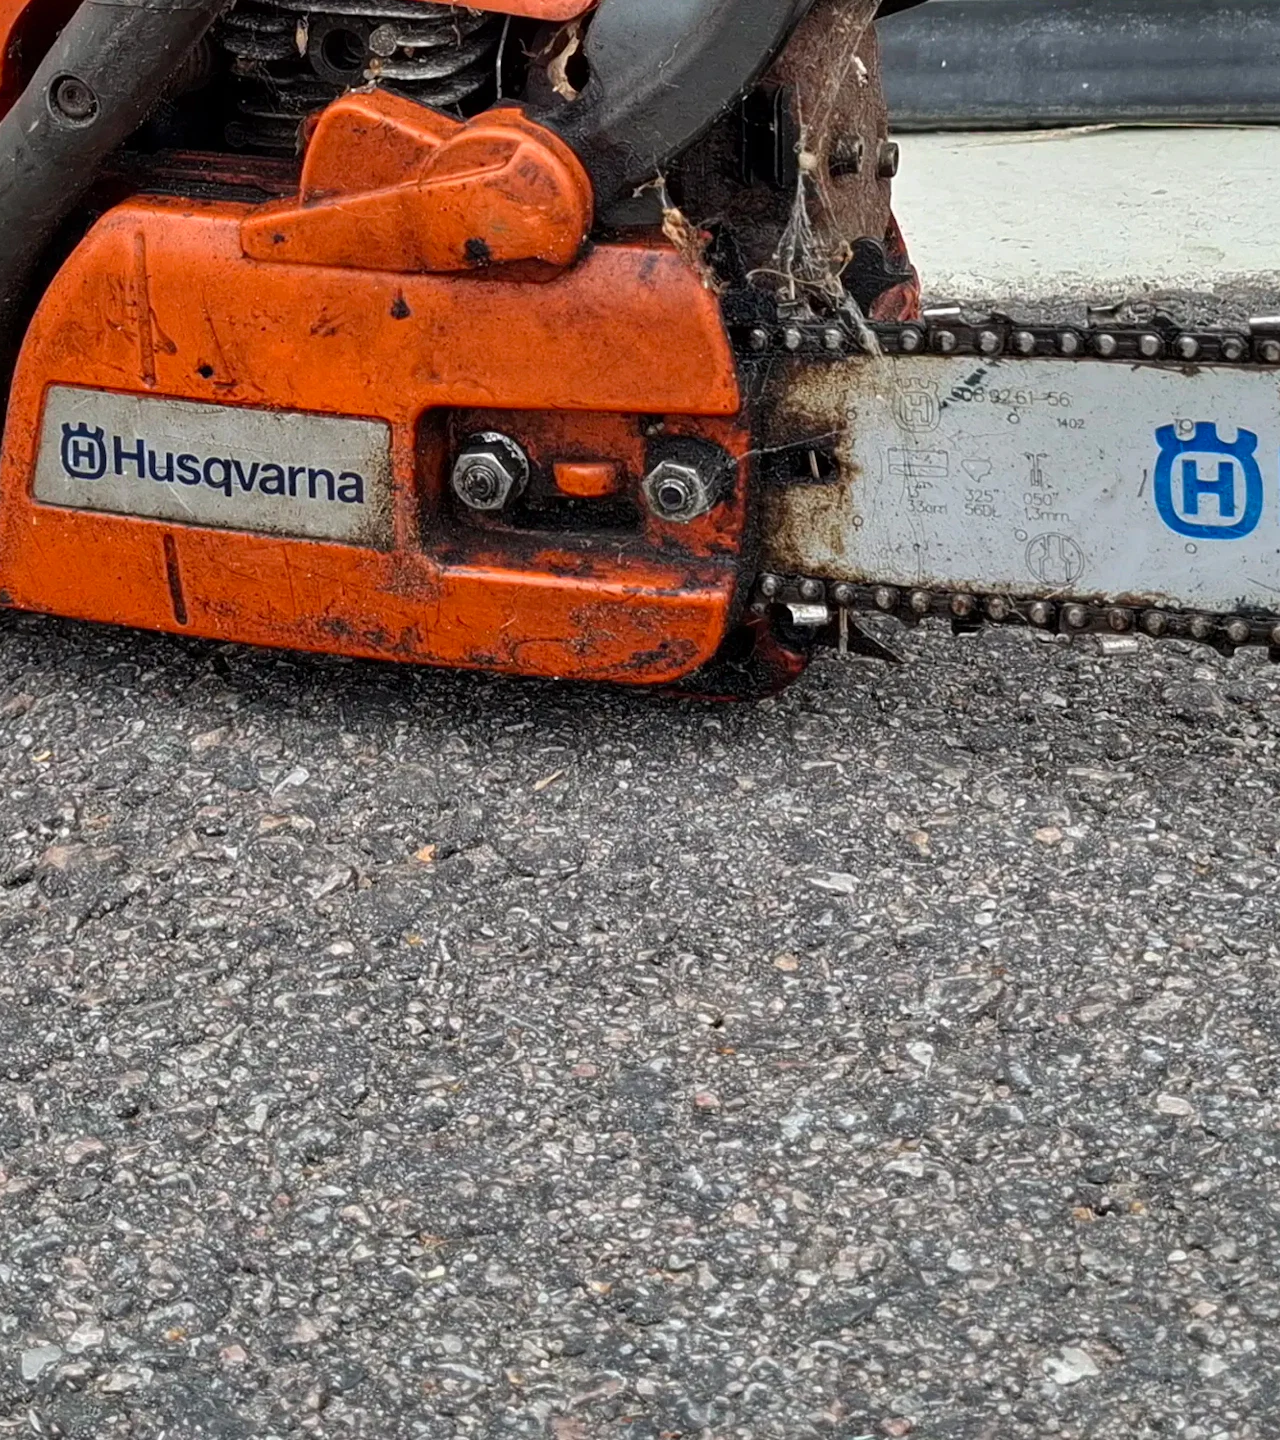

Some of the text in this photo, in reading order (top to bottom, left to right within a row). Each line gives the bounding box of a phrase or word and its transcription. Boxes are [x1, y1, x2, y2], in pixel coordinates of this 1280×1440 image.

[952, 386, 985, 403] 08
[1056, 418, 1085, 430] 1402
[112, 435, 365, 504] Husqvarna
